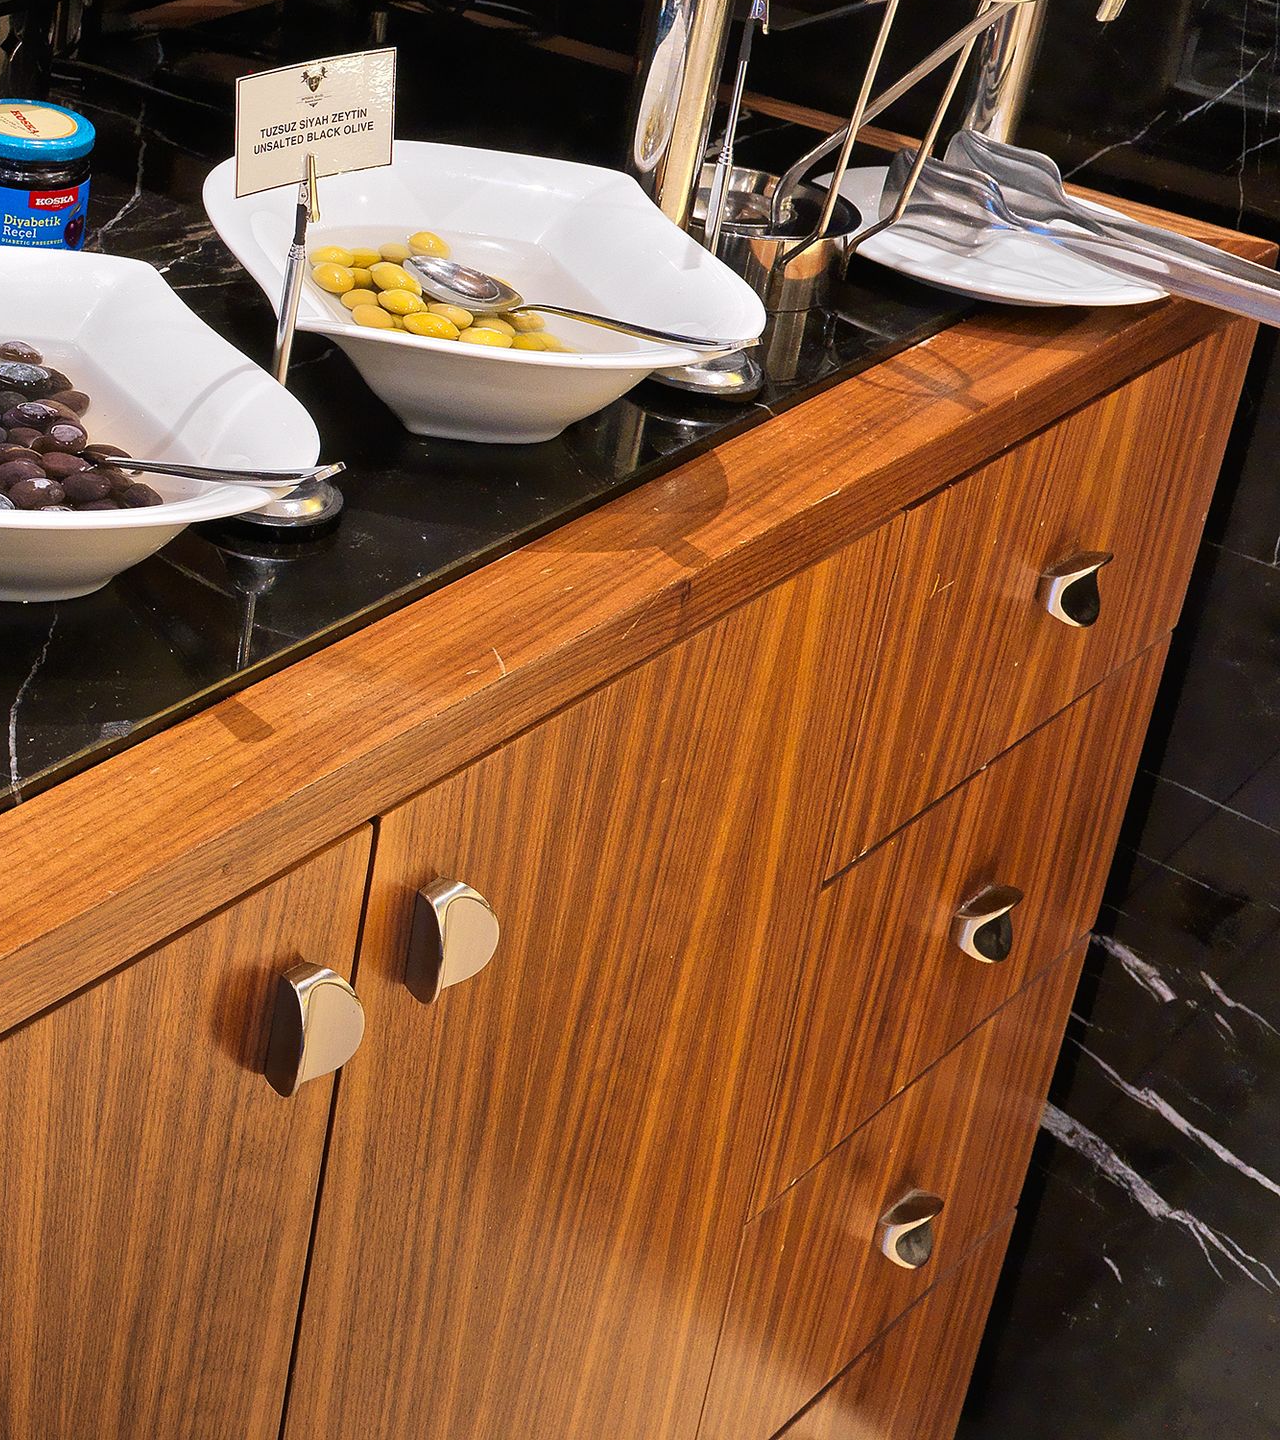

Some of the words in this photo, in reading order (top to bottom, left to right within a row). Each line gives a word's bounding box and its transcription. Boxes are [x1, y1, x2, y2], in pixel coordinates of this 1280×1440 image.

[10, 110, 40, 135] KOSKA
[260, 121, 297, 139] TUZSUZ
[299, 115, 329, 130] SİYAH
[331, 107, 368, 123] ZEYTİN
[253, 135, 304, 155] UNSALTED
[306, 127, 341, 143] BLACK
[343, 121, 374, 135] OLIVE
[35, 194, 74, 206] KOSKA
[3, 214, 61, 229] Diyabetik
[2, 225, 37, 239] Reçel
[1, 237, 30, 246] DIABETIC
